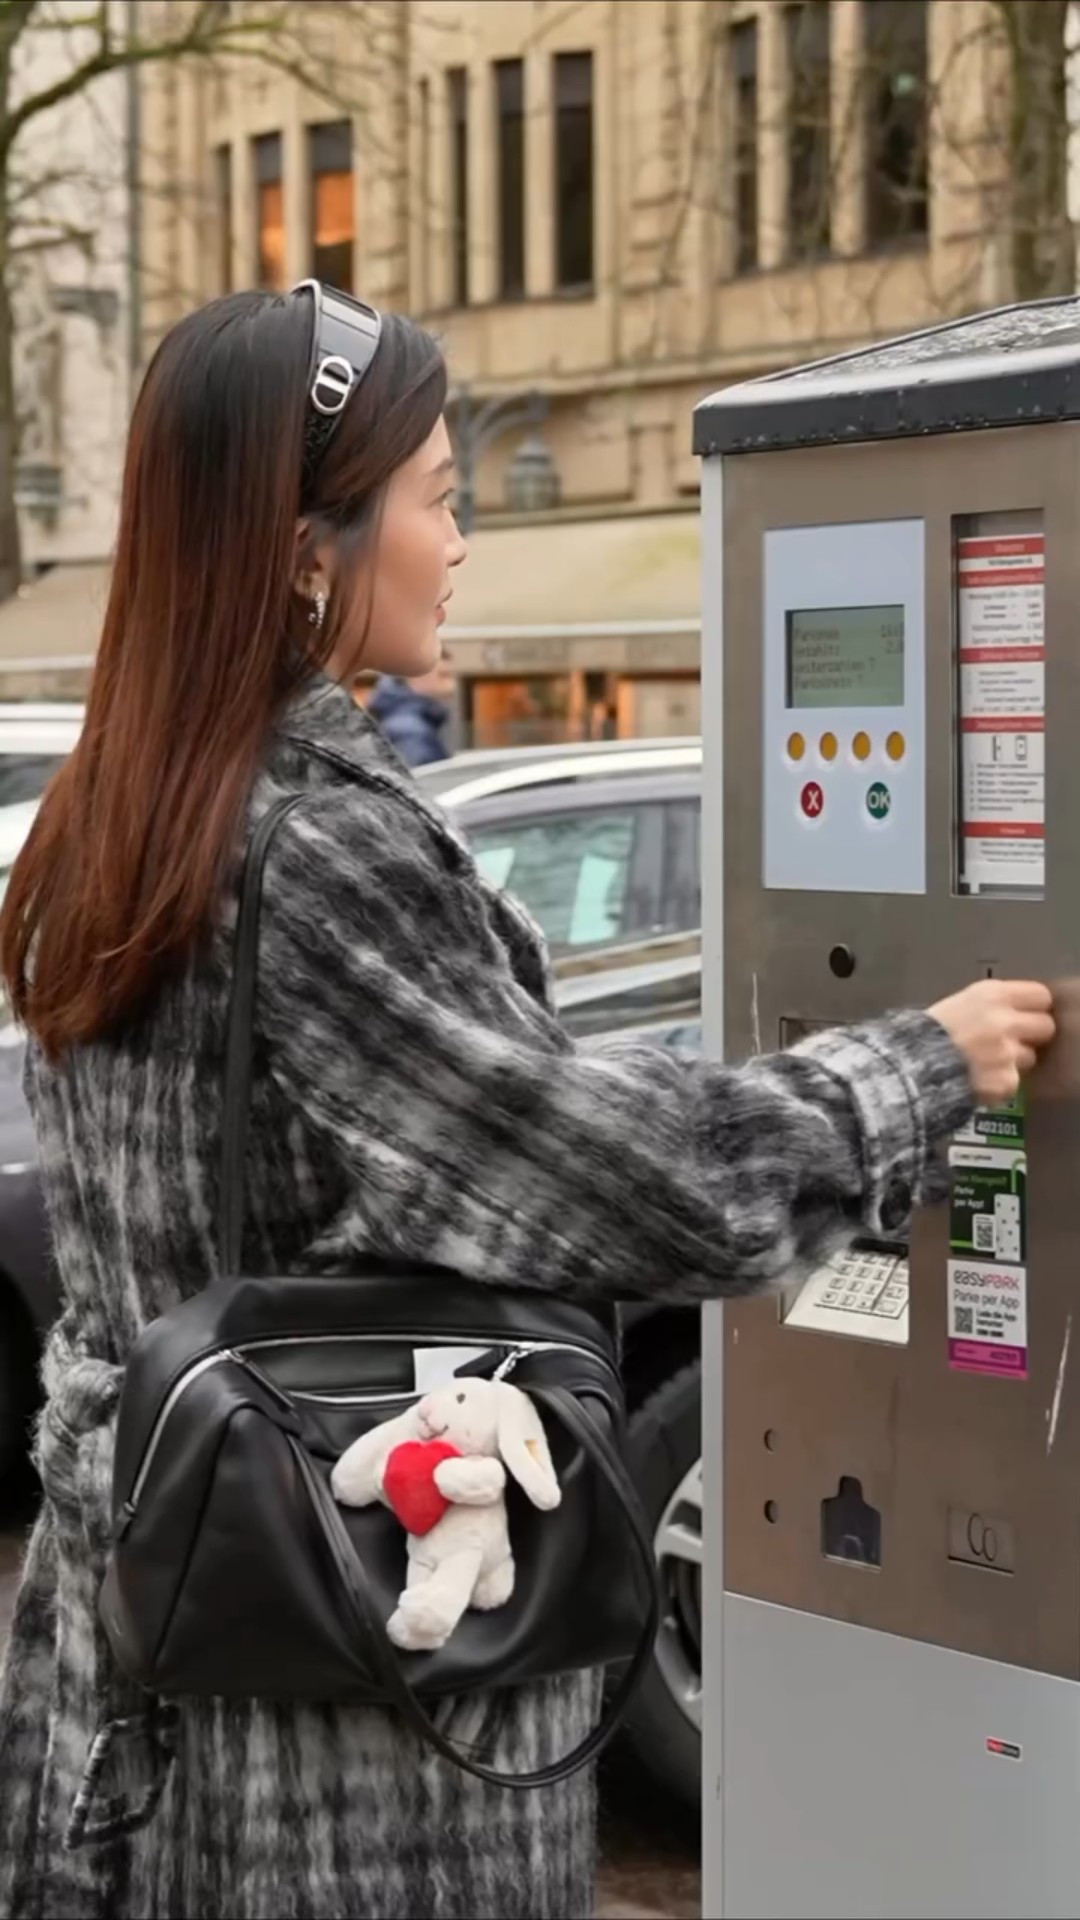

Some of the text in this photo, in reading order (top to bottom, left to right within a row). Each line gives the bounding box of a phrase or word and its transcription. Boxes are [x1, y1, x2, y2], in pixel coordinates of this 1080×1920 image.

[807, 790, 820, 811] X
[869, 791, 891, 809] OK
[954, 1289, 1020, 1311] Parke per App
